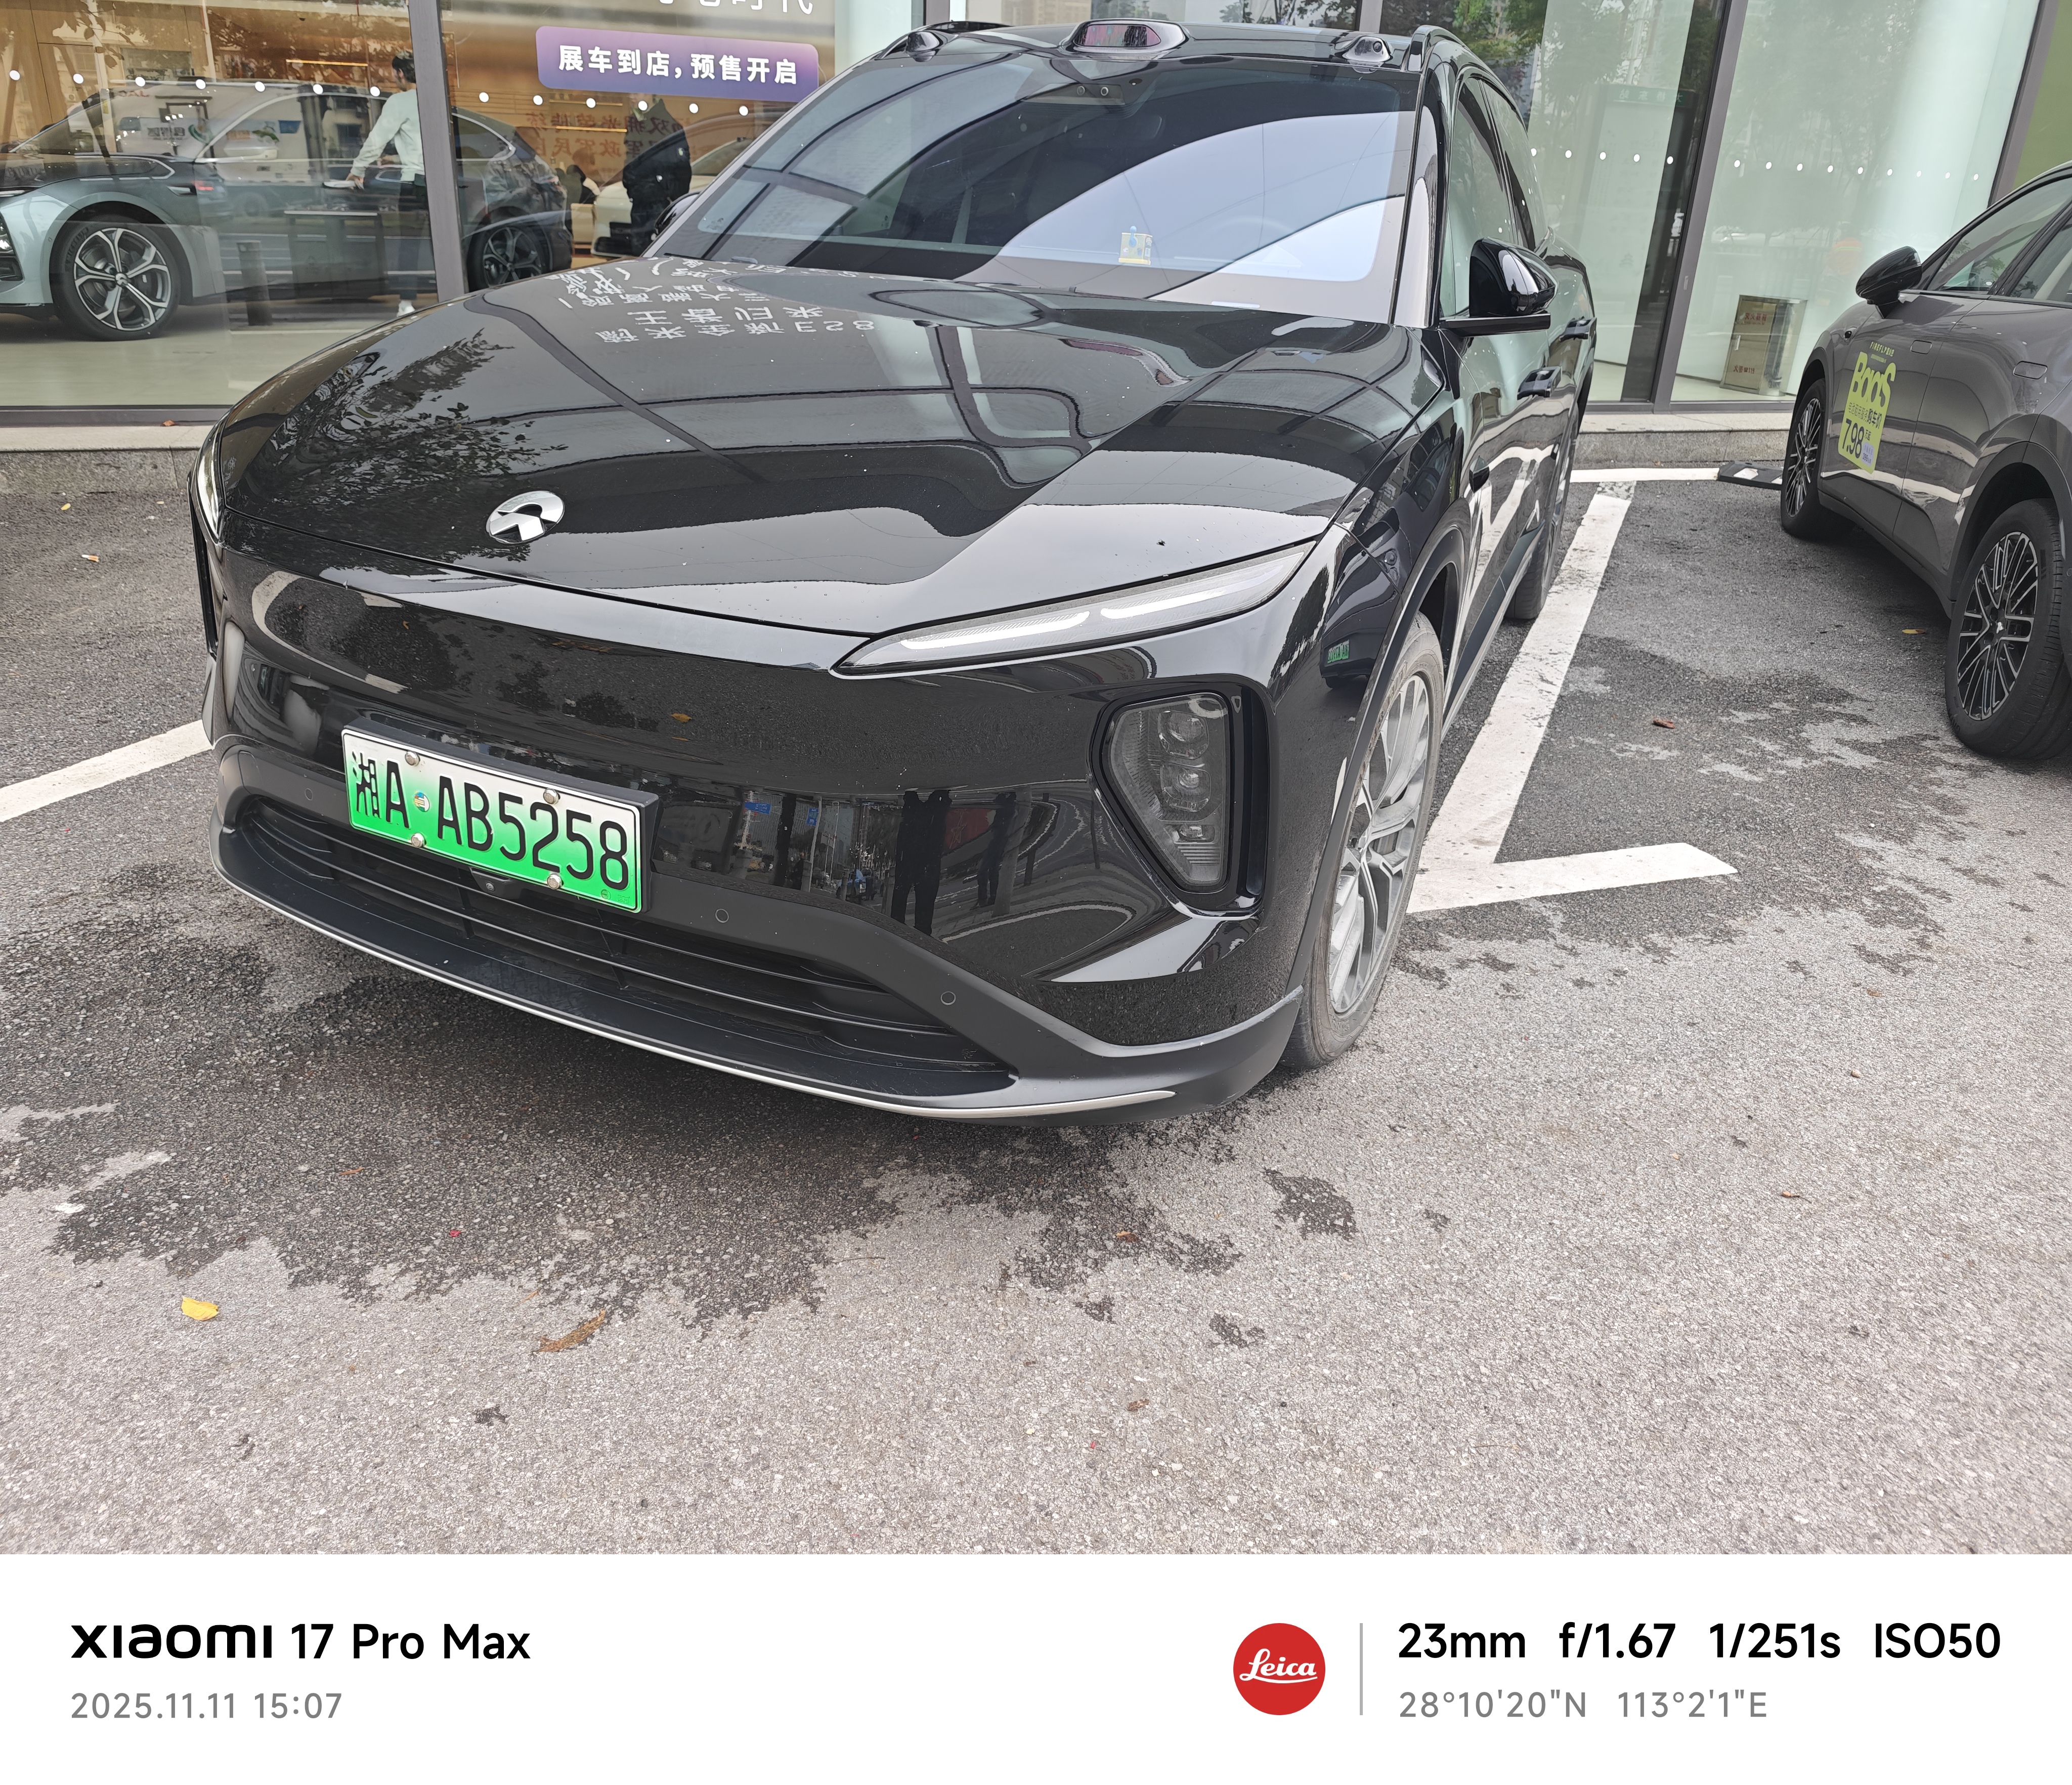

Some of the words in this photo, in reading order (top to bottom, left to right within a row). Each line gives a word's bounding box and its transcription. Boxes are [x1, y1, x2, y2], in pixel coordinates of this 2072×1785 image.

[558, 45, 797, 85] 展车到店，预售开启
[1842, 418, 1865, 459] 7.98
[438, 775, 629, 891] AB5258
